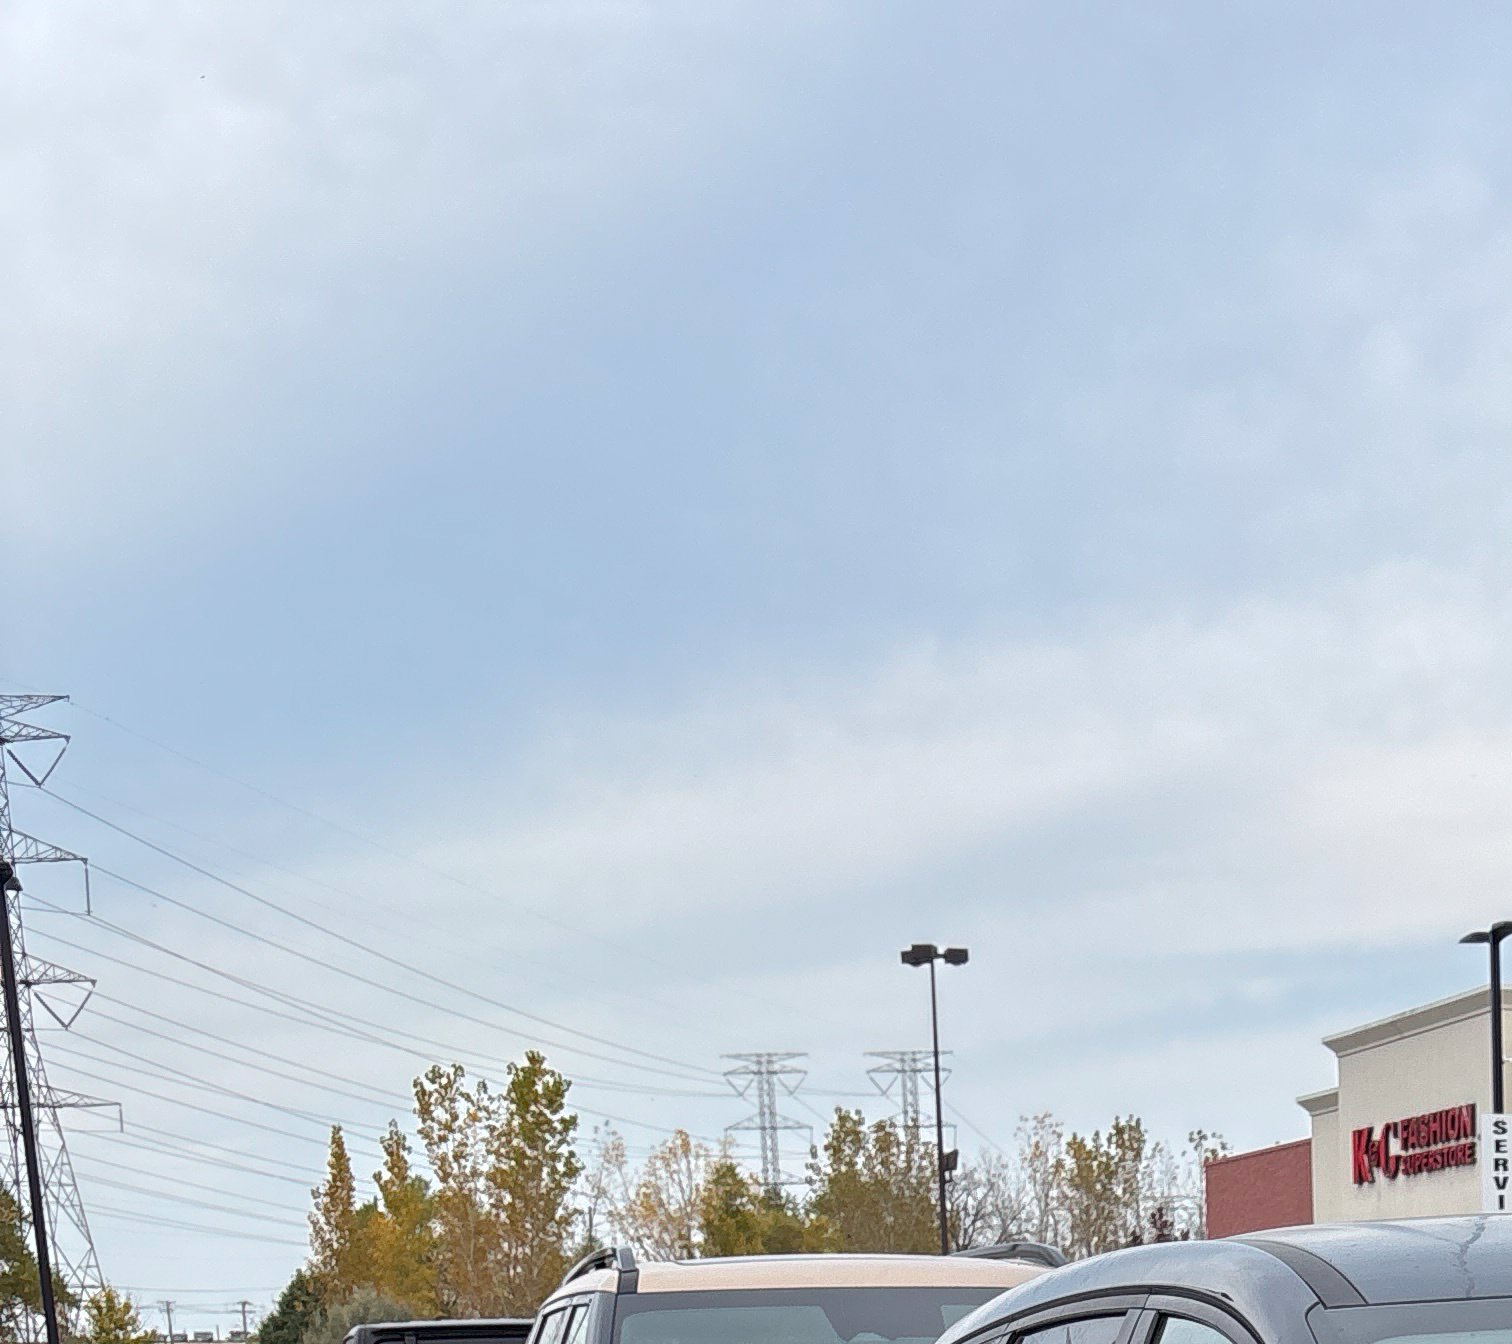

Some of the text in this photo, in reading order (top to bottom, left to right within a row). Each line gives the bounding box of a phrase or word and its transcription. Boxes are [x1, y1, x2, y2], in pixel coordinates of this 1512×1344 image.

[1400, 1103, 1477, 1152] FASHION
[1400, 1142, 1477, 1176] SUPERSTORE
[1492, 1120, 1510, 1210] SERVI
